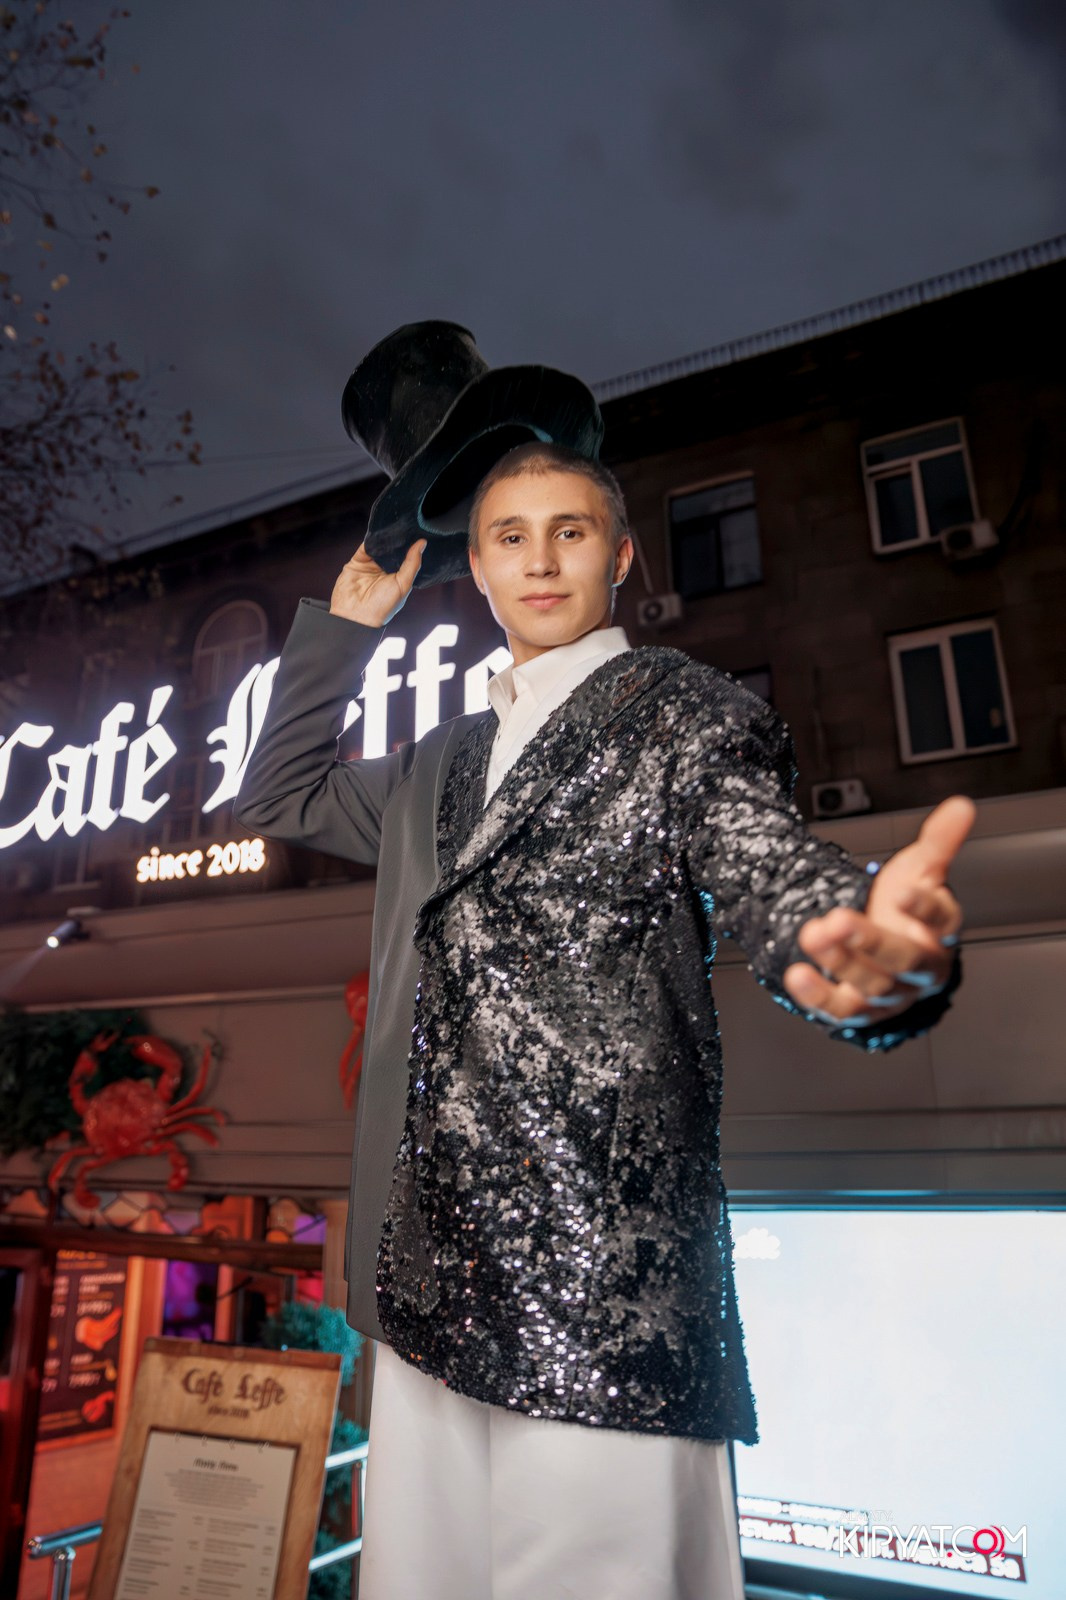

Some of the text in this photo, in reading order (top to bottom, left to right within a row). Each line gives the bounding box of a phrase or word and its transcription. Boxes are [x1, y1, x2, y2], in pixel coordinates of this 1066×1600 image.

[0, 685, 177, 849] Café
[136, 838, 266, 883] since 2018
[234, 1372, 288, 1412] Leffe
